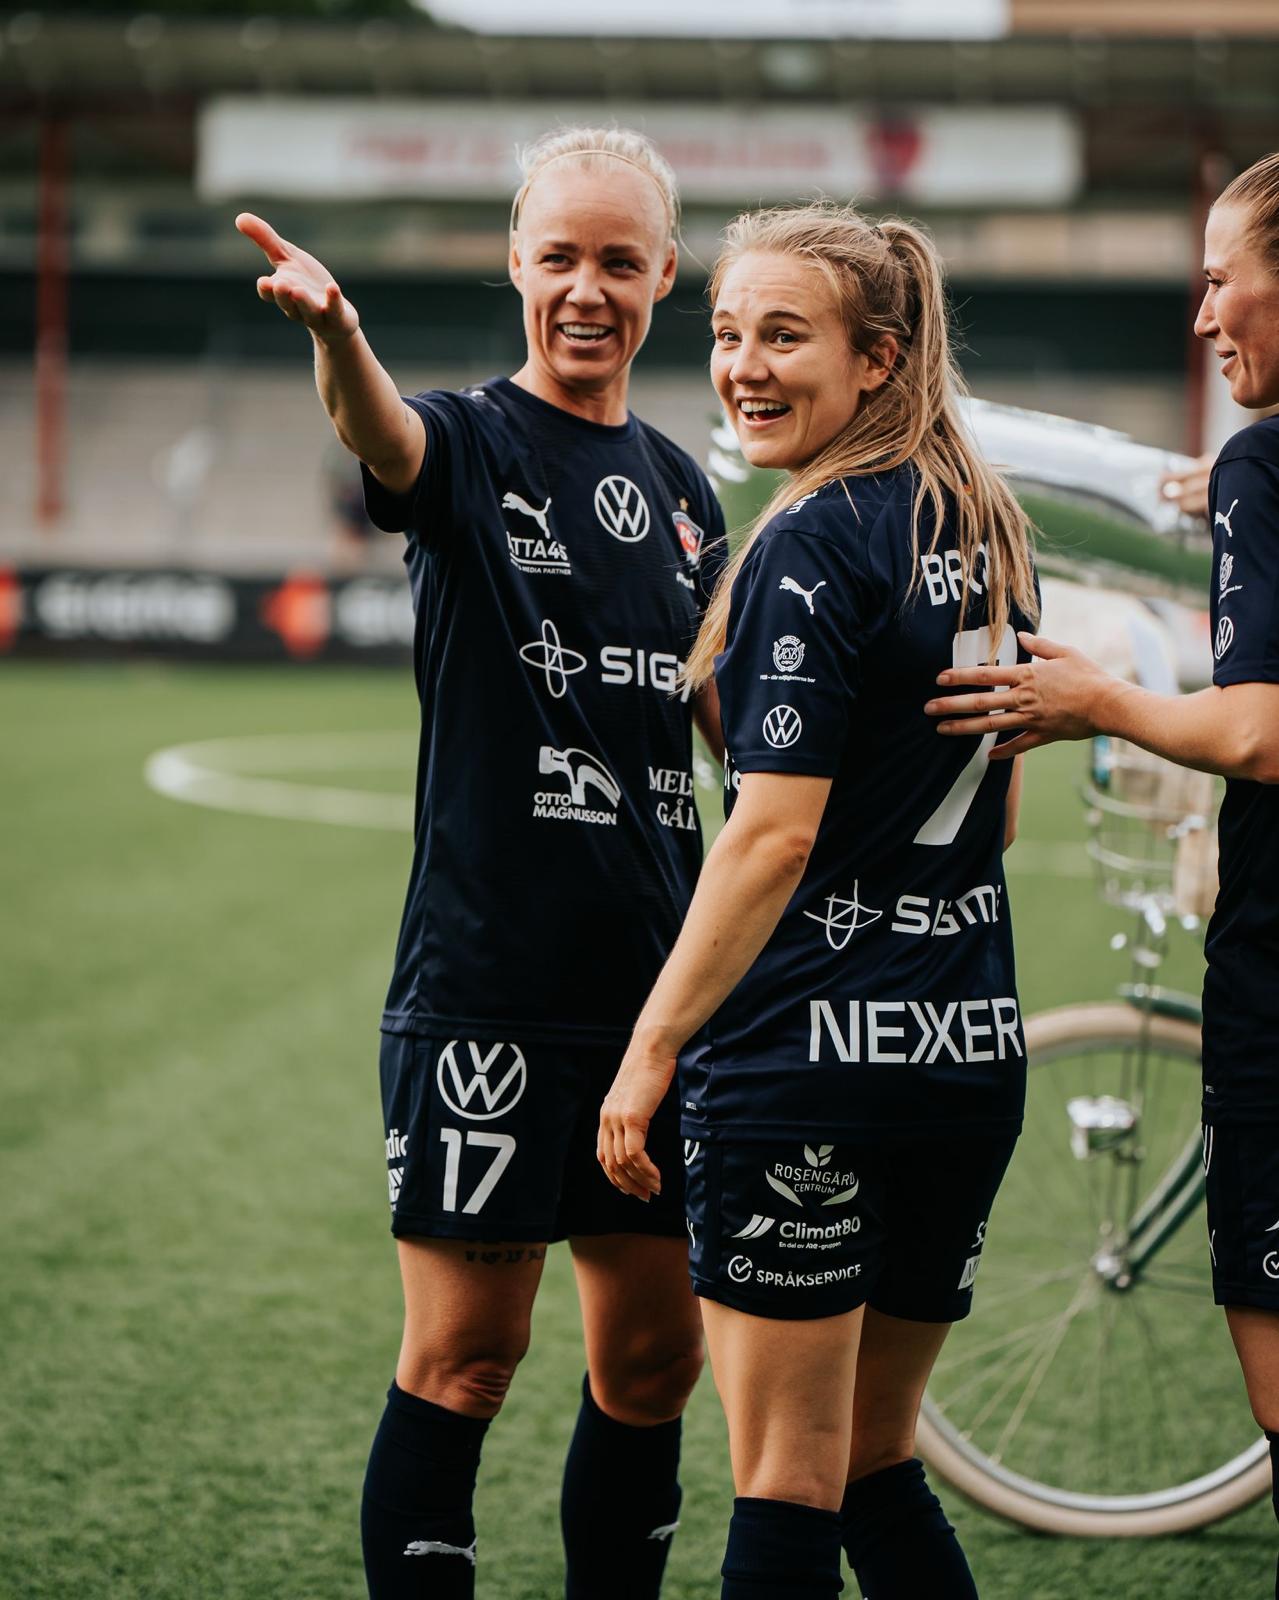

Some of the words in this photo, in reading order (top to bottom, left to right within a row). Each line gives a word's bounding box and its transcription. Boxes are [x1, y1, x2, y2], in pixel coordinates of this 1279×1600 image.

[595, 476, 650, 542] VW
[543, 567, 573, 576] PARTNER
[762, 704, 802, 749] VW
[534, 792, 571, 806] OTTO
[533, 804, 618, 826] MAGNUSSON
[436, 1040, 527, 1121] VW
[440, 1127, 517, 1215] 17
[774, 1163, 856, 1187] ROSENGÅRD
[794, 1184, 836, 1195] CENTRUM
[779, 1216, 862, 1240] Climat80
[756, 1263, 862, 1288] SPRÅKSERVICE
